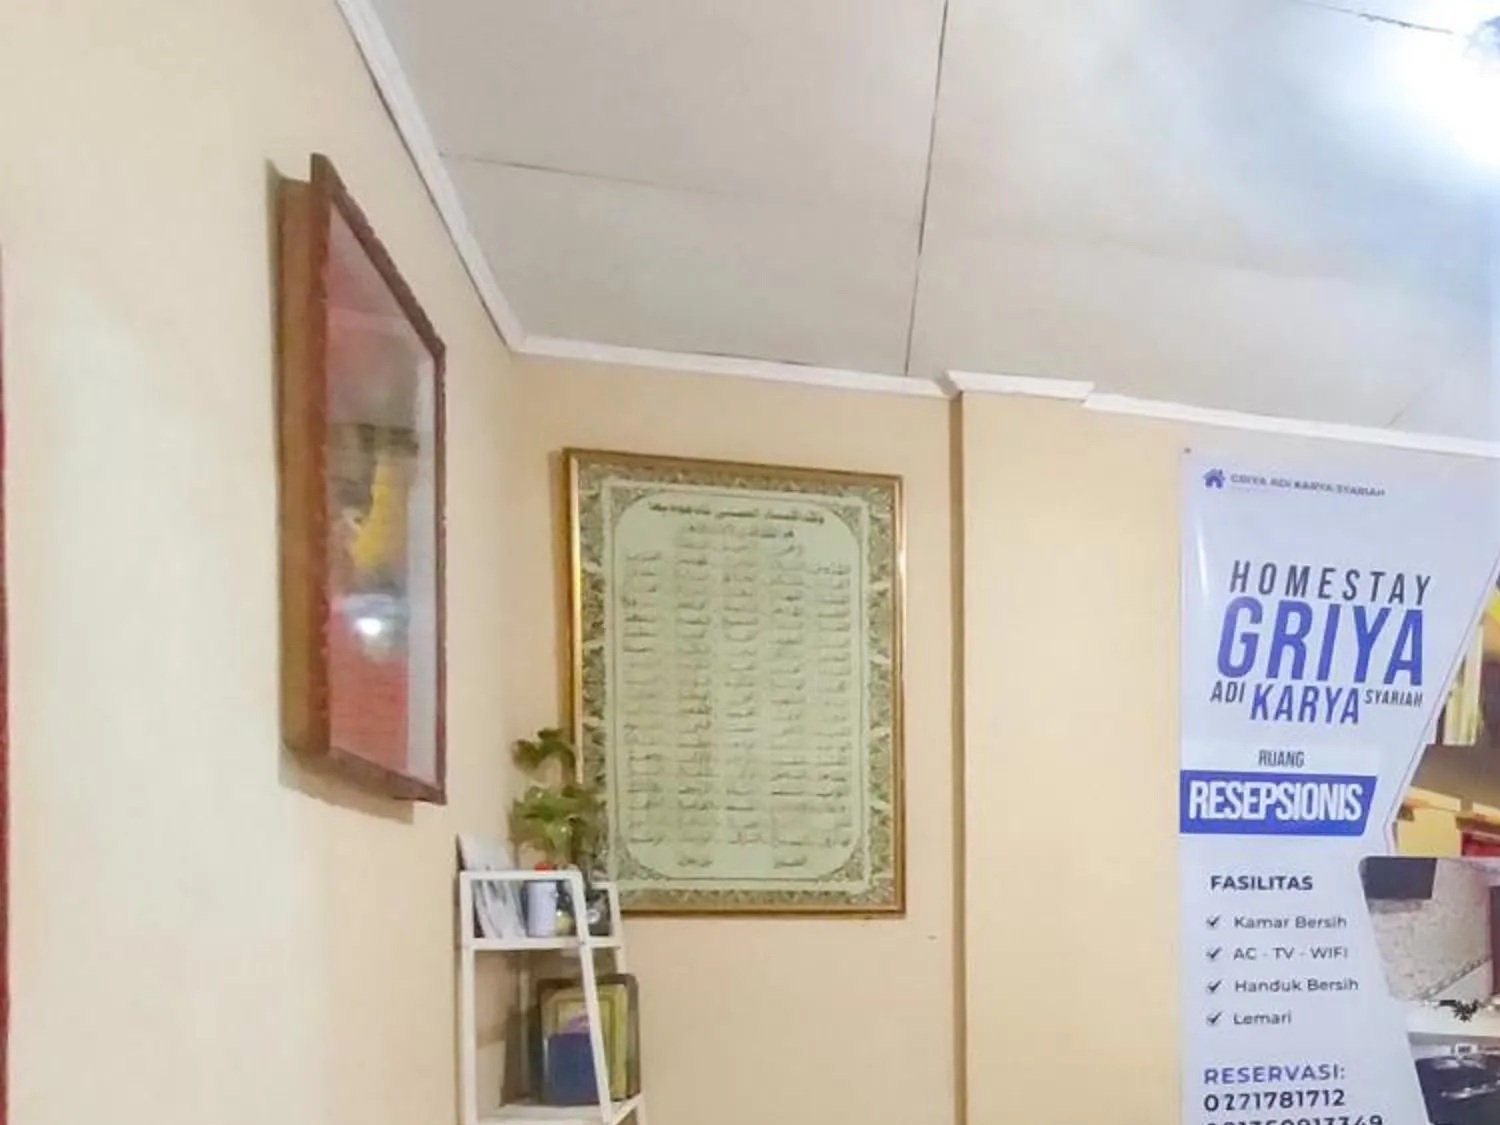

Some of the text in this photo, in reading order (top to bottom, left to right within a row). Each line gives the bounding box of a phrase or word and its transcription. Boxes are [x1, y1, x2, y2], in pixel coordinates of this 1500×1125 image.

[1230, 473, 1385, 497] GRIYA ADI KARYA SYARIAH
[1229, 559, 1432, 606] HOMESTAY
[1216, 595, 1424, 686] GRIYA
[1210, 681, 1423, 725] ADI KARYA SYARIAH
[1258, 749, 1305, 768] RUANG
[1188, 779, 1364, 822] RESEPSIONIS
[1210, 875, 1314, 891] FASILITAS
[1233, 915, 1347, 929] Kamar Bersih
[1233, 947, 1257, 961] AC
[1273, 947, 1295, 960] TV
[1309, 947, 1348, 960] WIFI
[1234, 977, 1359, 993] Handuk Bersih
[1233, 1010, 1293, 1025] Lemari
[1204, 1064, 1346, 1085] RESERVASI:
[1204, 1089, 1346, 1112] 0271781712
